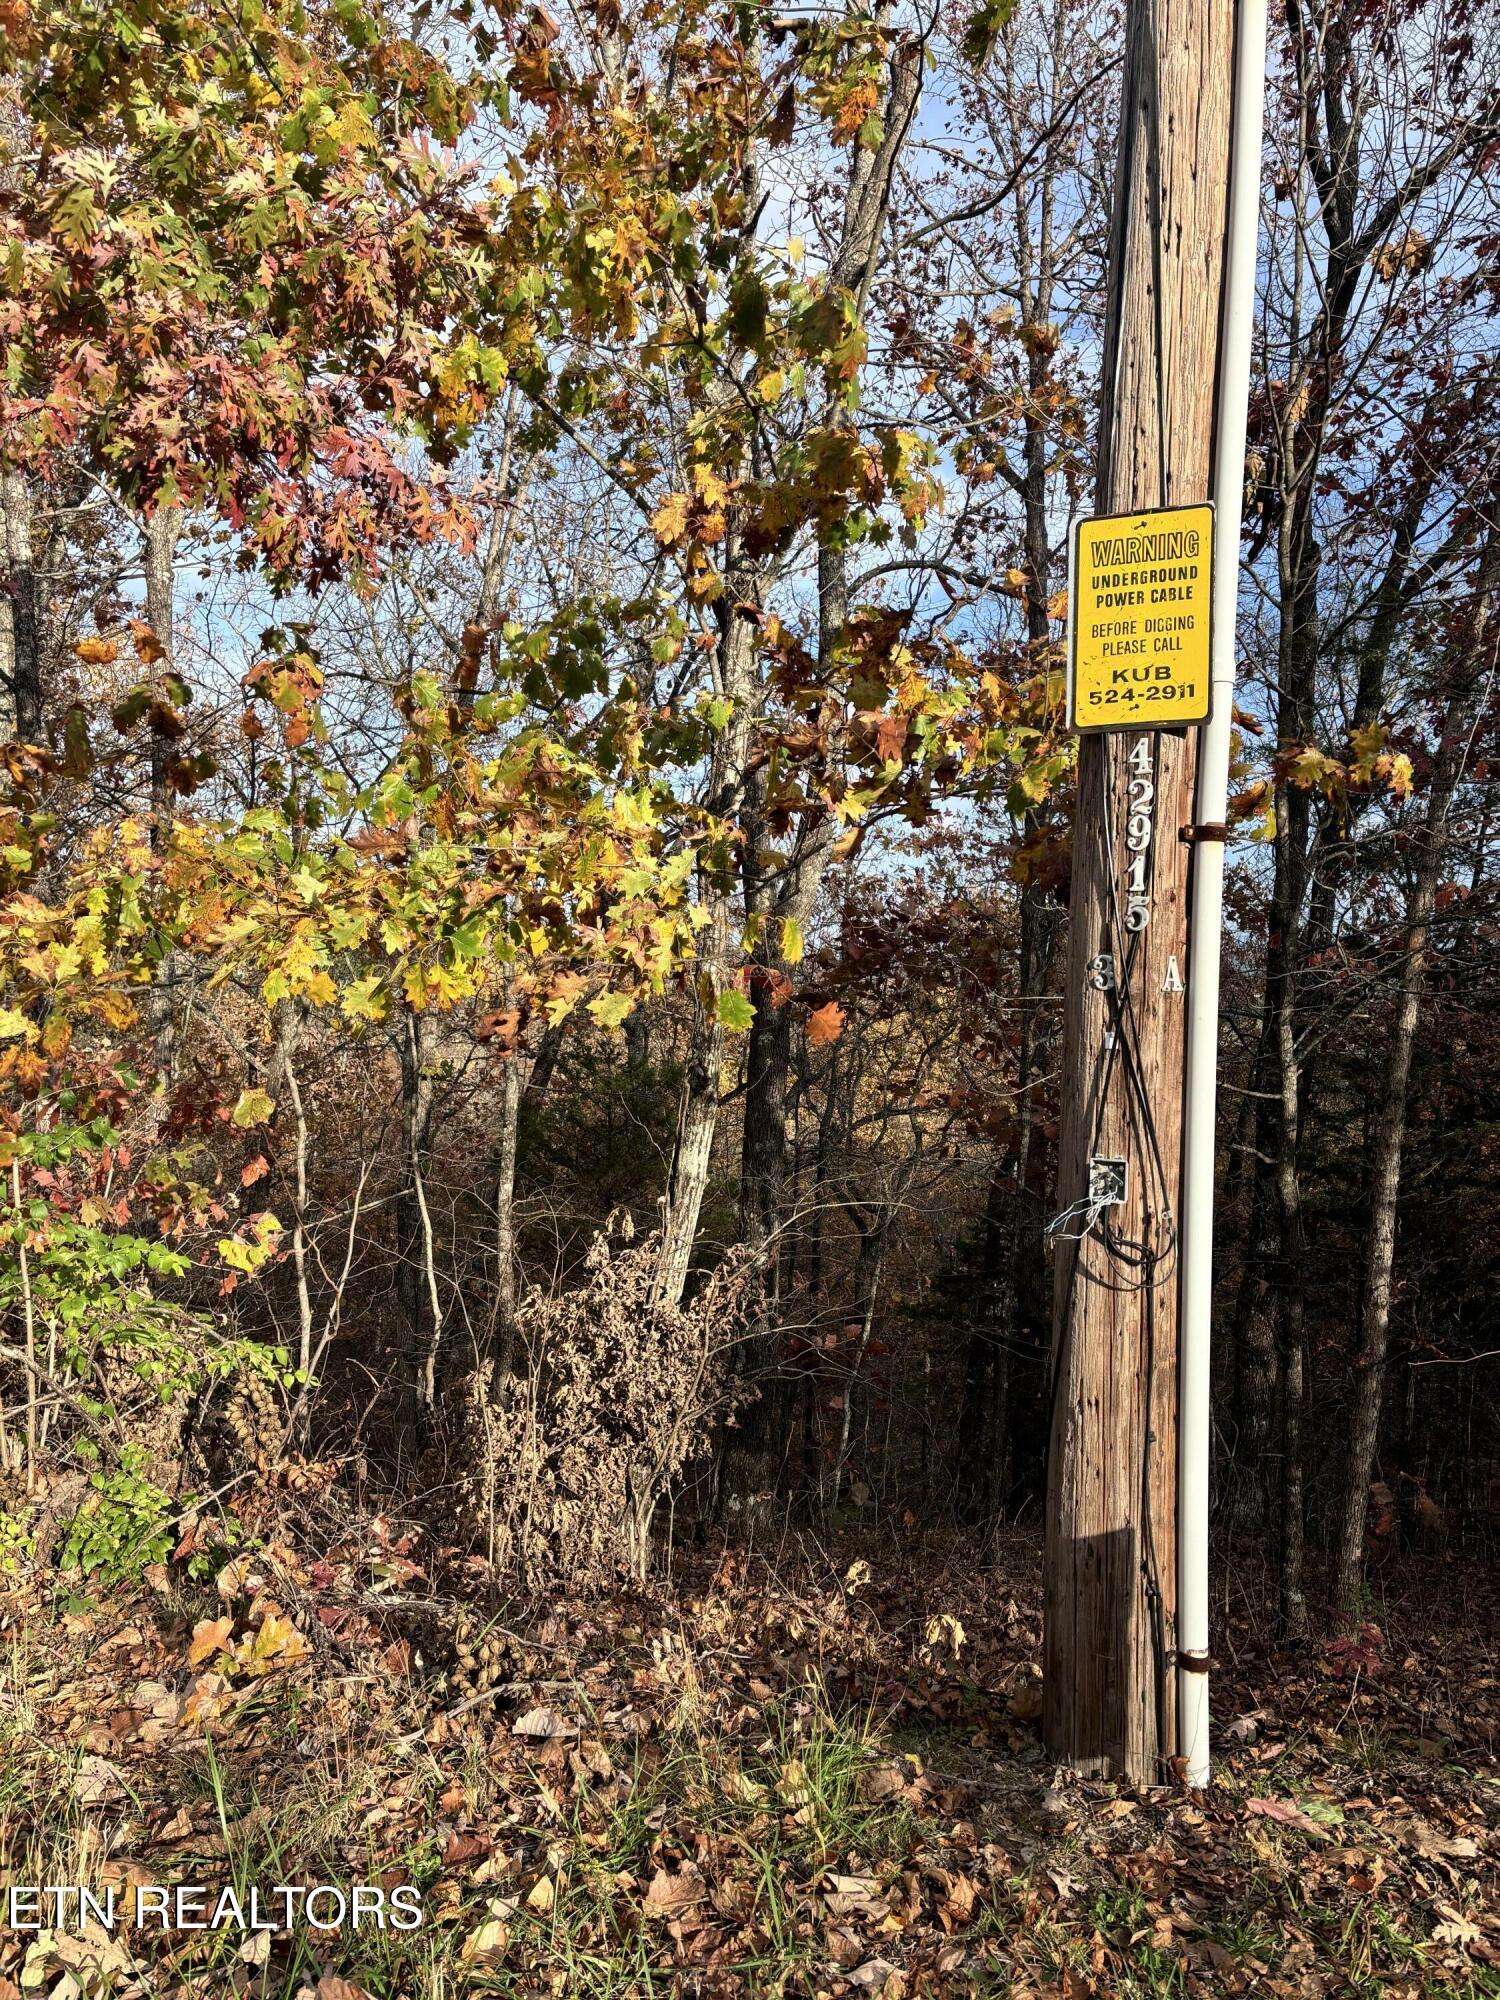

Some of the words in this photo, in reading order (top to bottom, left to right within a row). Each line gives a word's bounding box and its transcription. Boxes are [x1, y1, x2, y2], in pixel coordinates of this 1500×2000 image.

[1091, 530, 1200, 568] WARNING
[1092, 565, 1198, 589] UNDERGROUND
[1096, 590, 1145, 608] POWER
[1150, 586, 1193, 604] CABLE
[1092, 620, 1137, 638] BEFORE
[1145, 615, 1194, 633] DIGGING
[1102, 639, 1147, 656] PLEASE
[1153, 637, 1183, 652] CALL
[1112, 665, 1172, 684] KUB
[1089, 684, 1195, 705] 524-2911
[1126, 737, 1155, 931] 42915
[1090, 954, 1115, 991] 3
[1161, 955, 1184, 992] A
